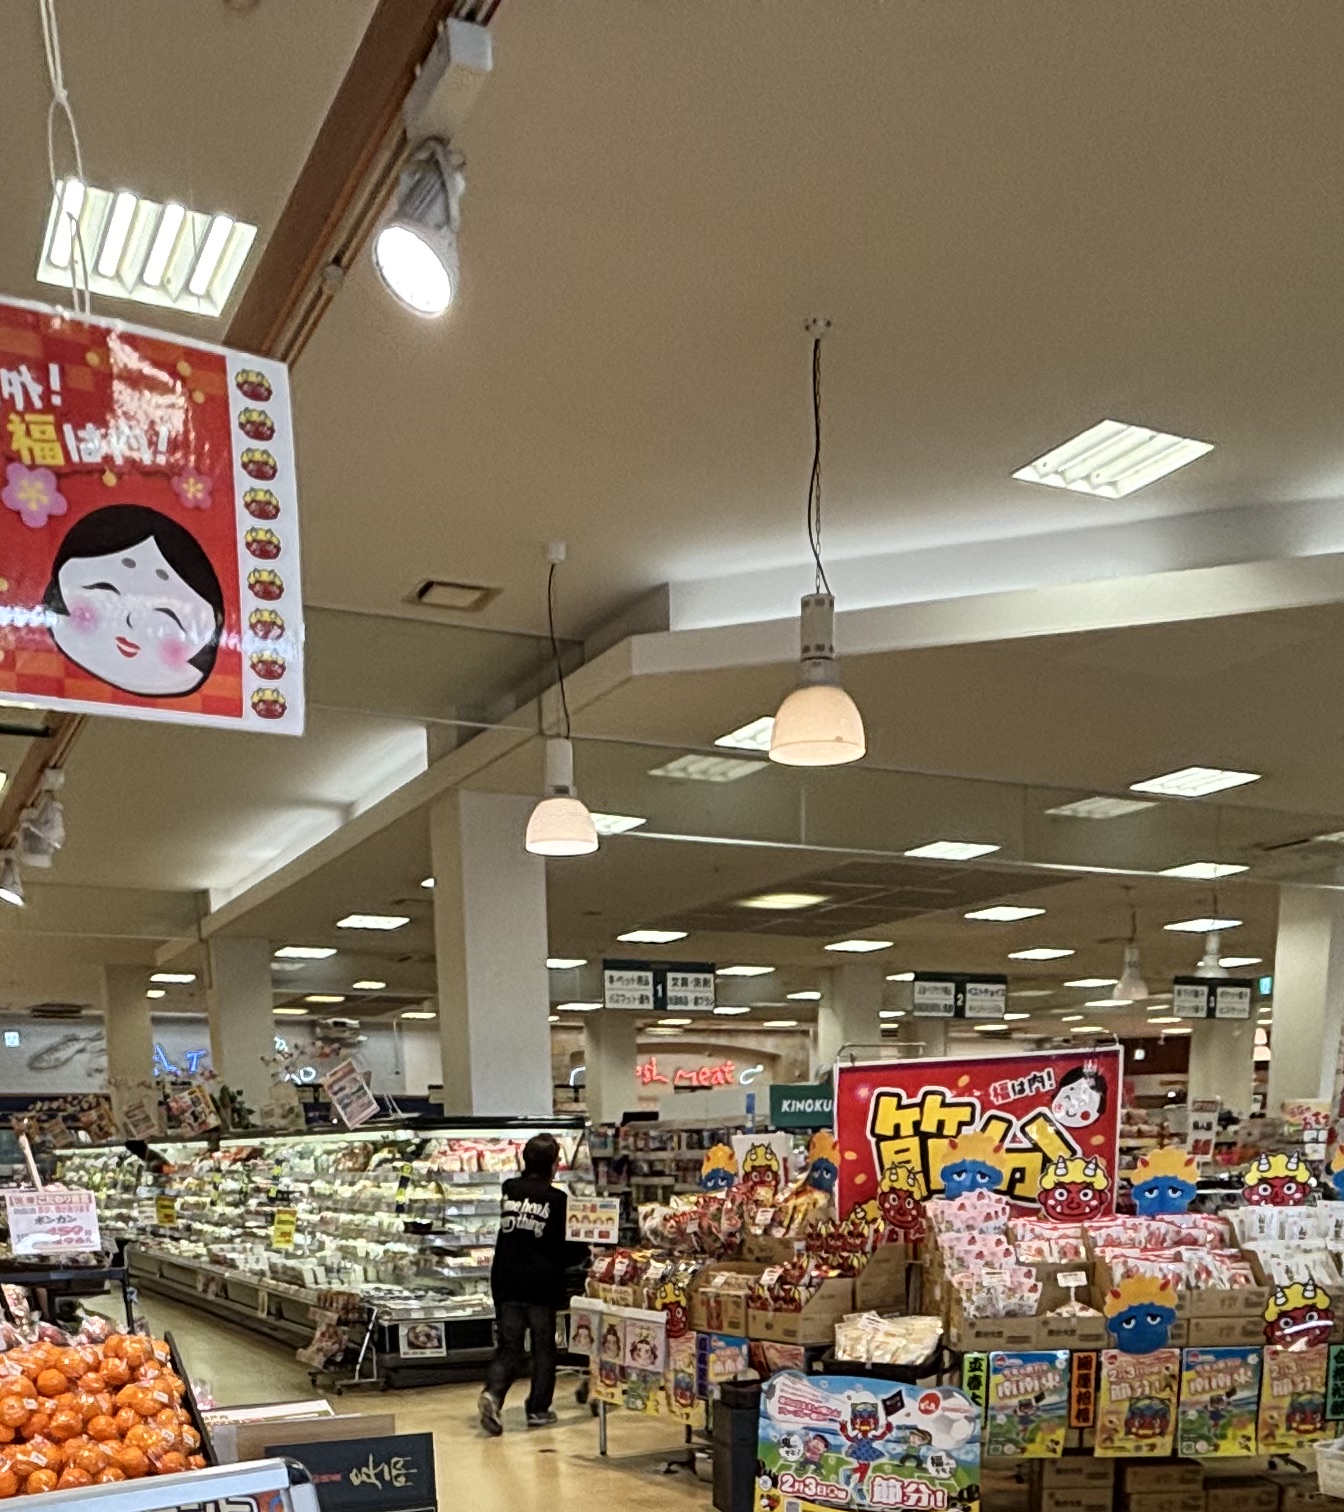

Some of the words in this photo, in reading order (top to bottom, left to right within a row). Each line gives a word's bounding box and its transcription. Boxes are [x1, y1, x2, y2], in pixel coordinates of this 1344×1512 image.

[956, 993, 965, 1006] 2
[674, 1060, 736, 1086] meat
[990, 1068, 1055, 1104] 福は内!
[35, 1215, 78, 1225] ポンカン
